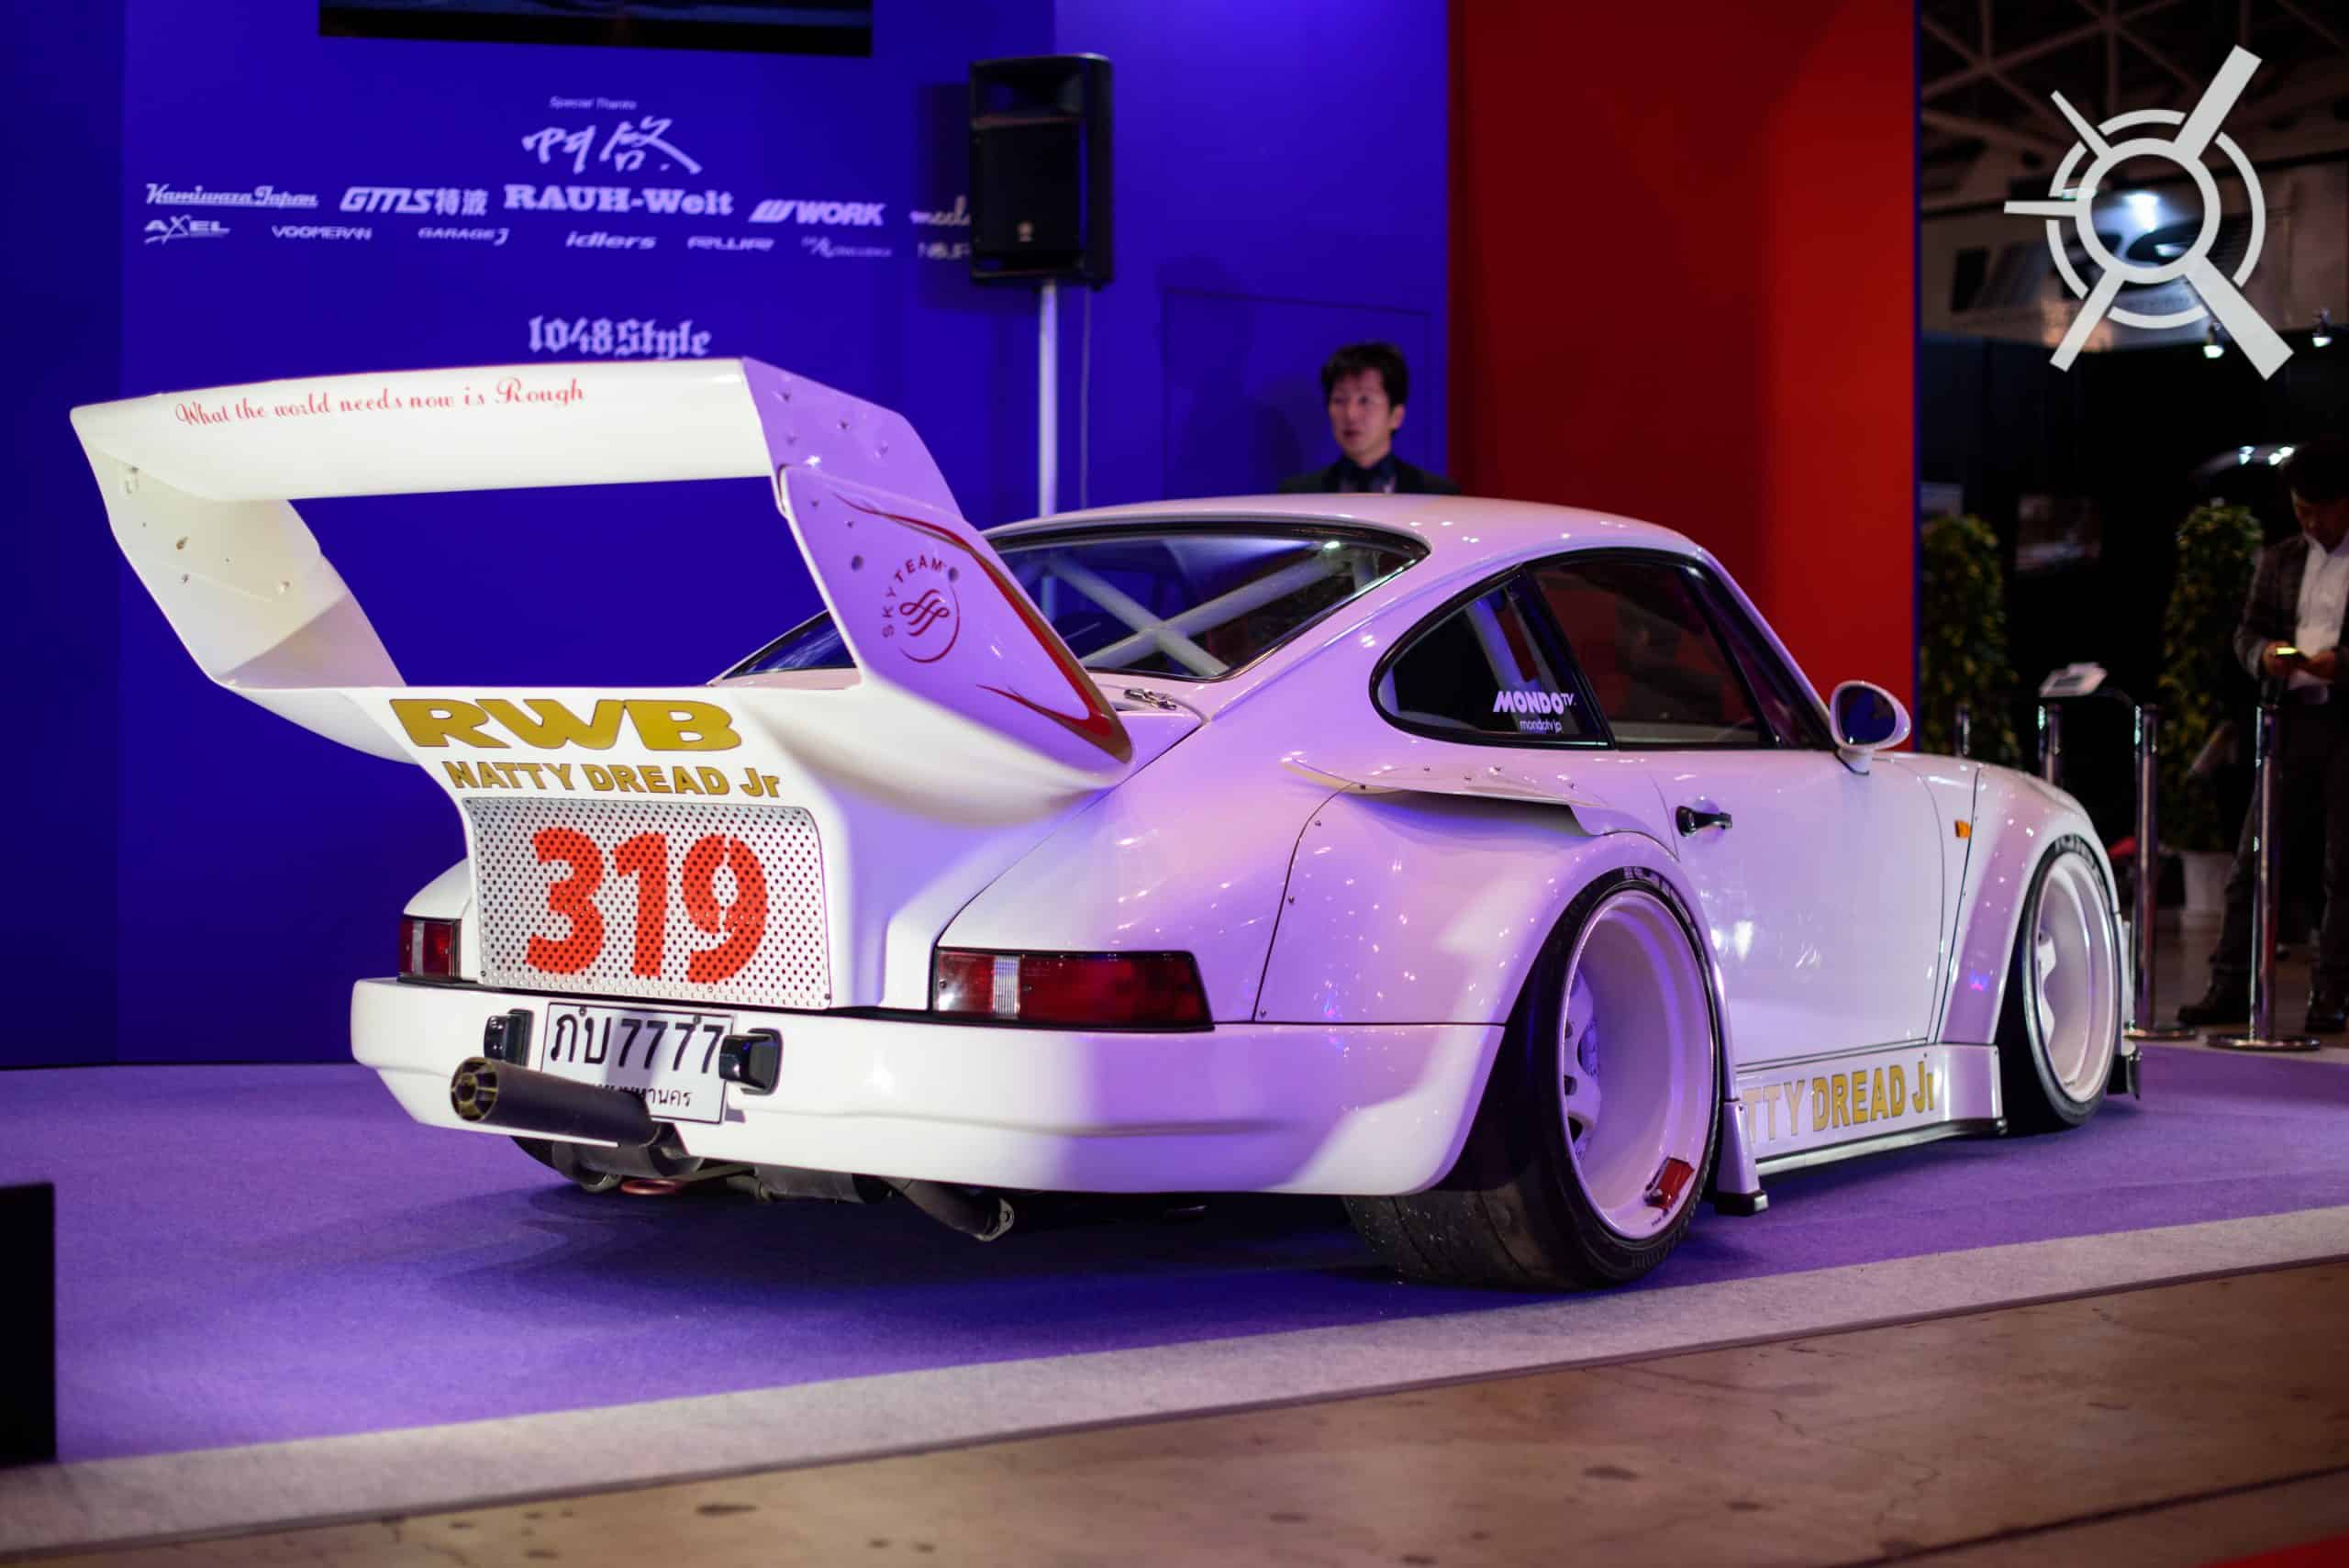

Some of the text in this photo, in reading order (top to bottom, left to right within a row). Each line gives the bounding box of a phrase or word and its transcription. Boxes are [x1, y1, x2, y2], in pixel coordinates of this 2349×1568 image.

[504, 184, 733, 216] RAUH-Welt
[796, 200, 885, 227] WORK
[144, 214, 231, 245] AXEL
[565, 231, 658, 250] idlers
[175, 377, 584, 426] What the world needs now is Rough
[389, 698, 742, 751] RWB
[442, 761, 781, 798] NATTY DREAD Jr
[525, 827, 769, 984] 319
[618, 1018, 725, 1074] 7777
[1743, 1079, 1806, 1146] TTY
[1812, 1063, 1906, 1132] DREAD
